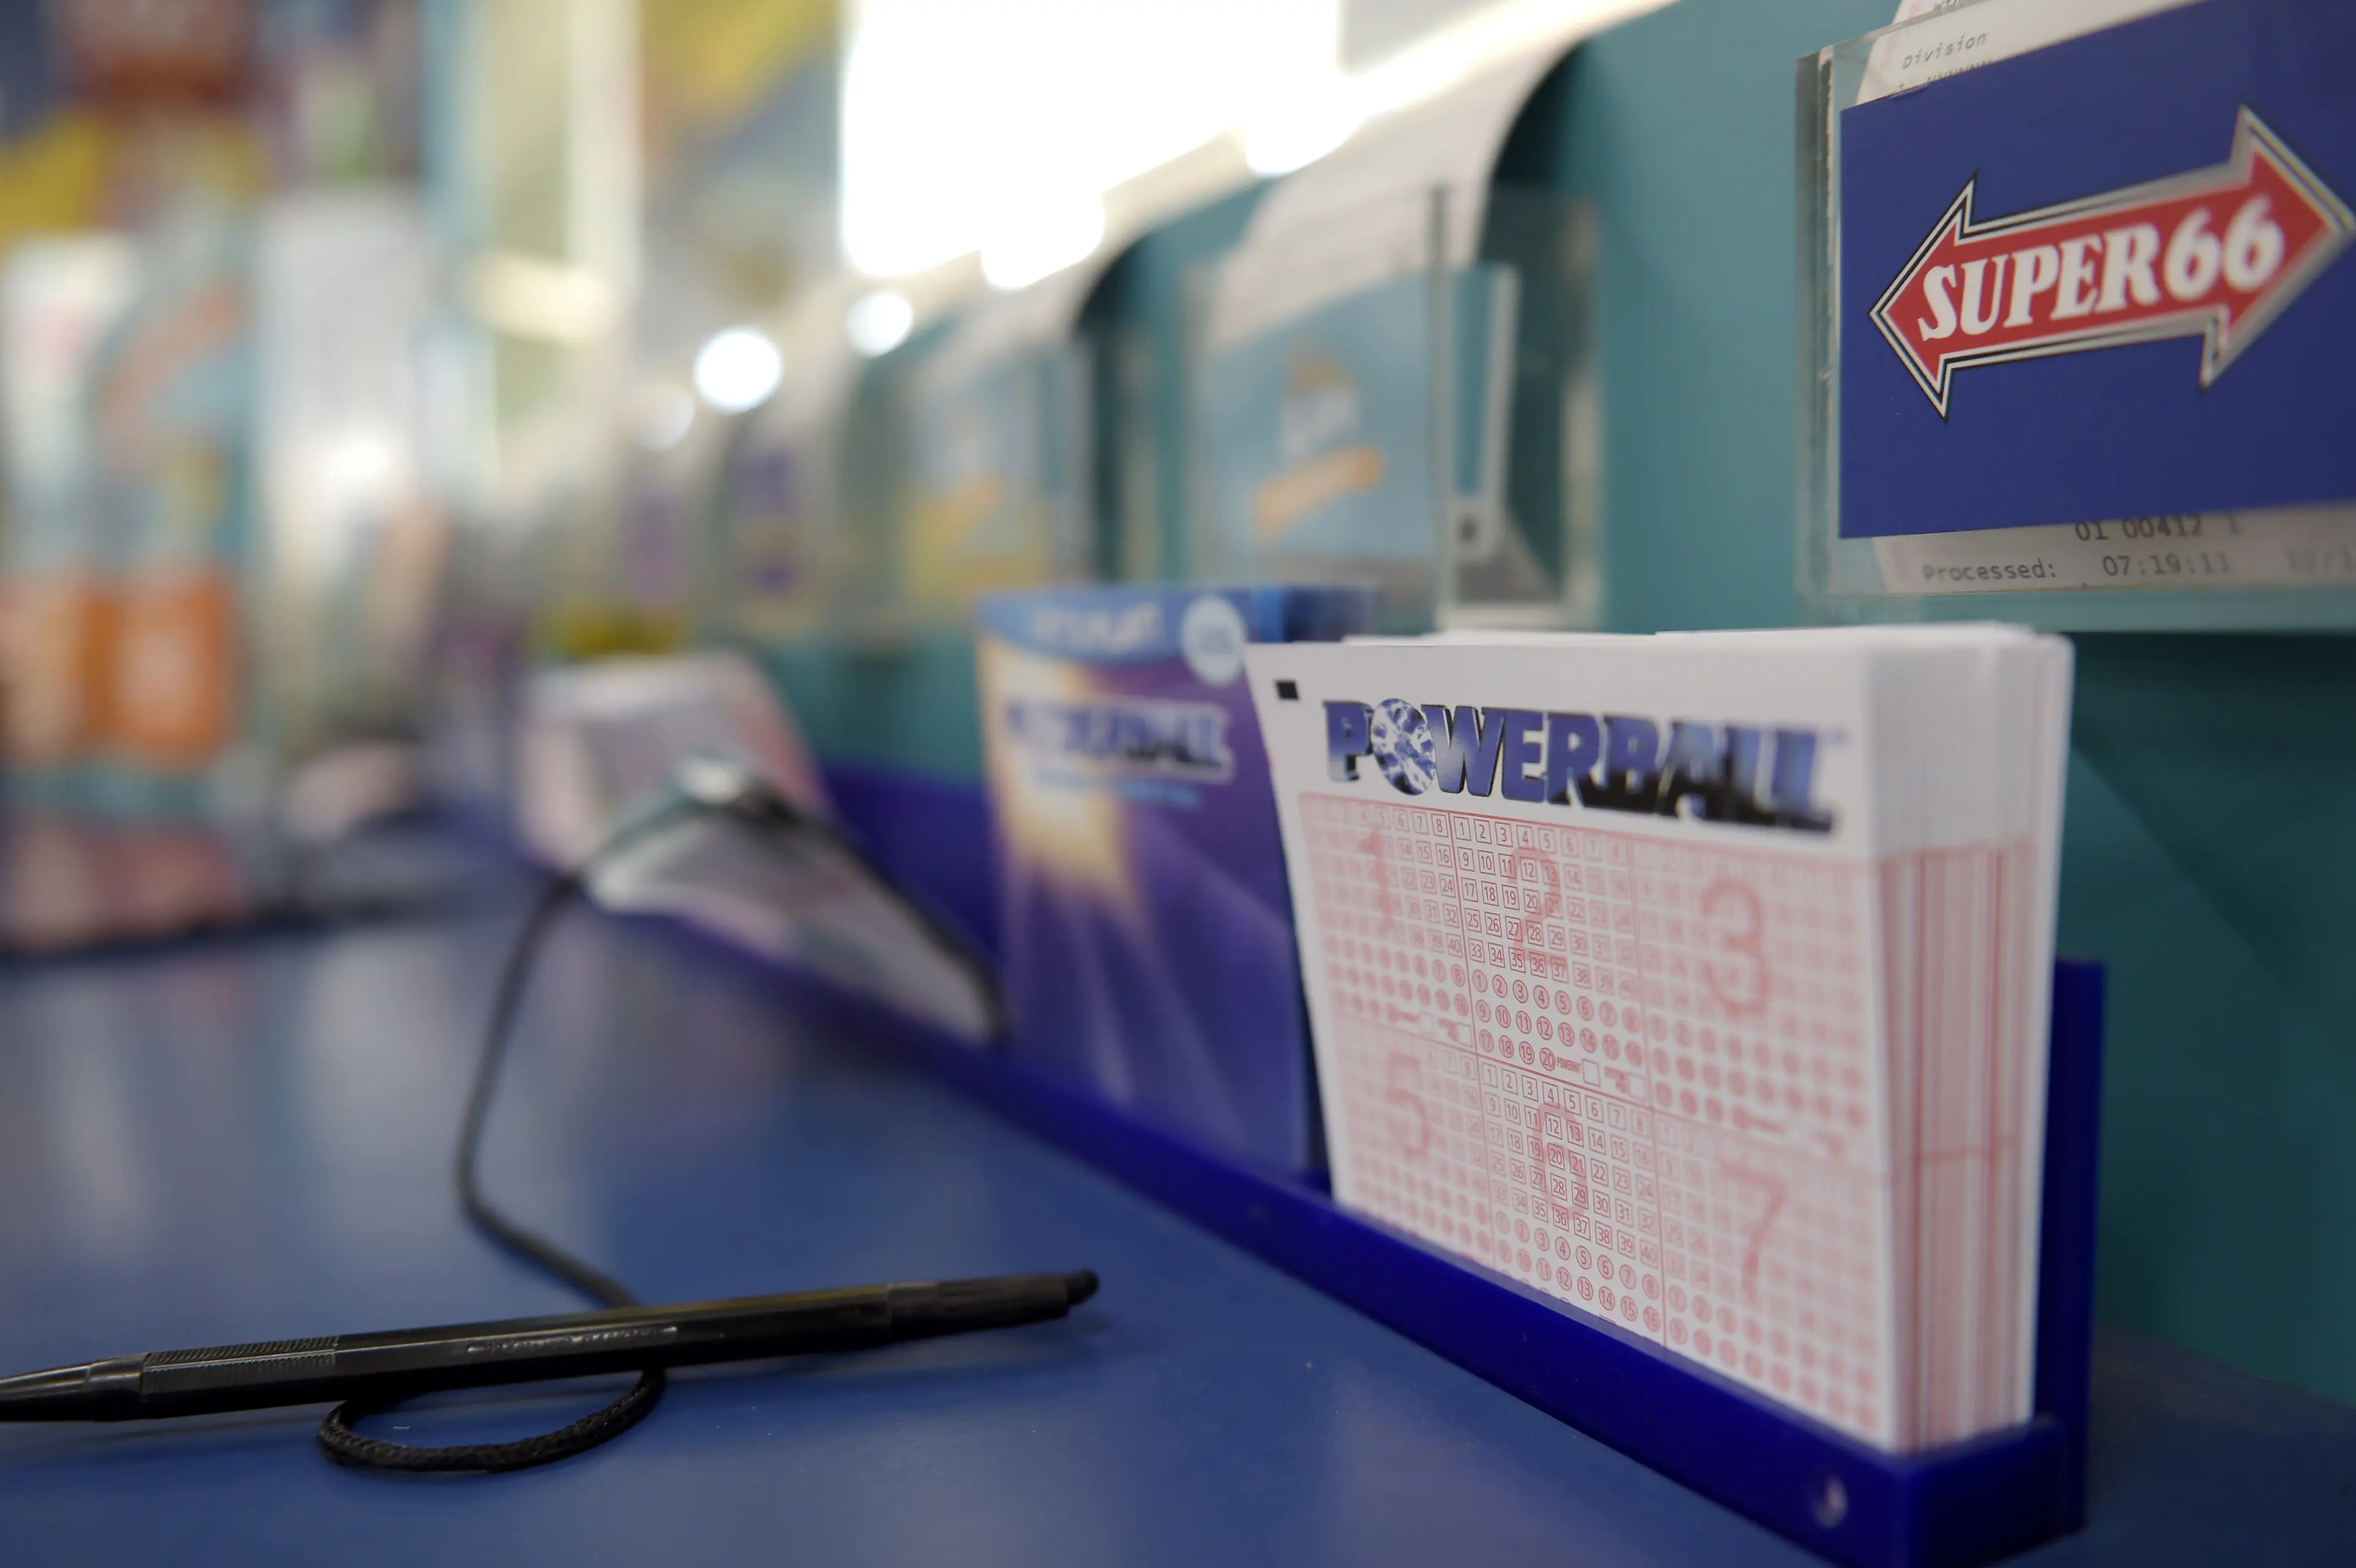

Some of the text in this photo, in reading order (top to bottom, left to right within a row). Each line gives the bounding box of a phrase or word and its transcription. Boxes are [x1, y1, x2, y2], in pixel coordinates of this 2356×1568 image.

[1903, 33, 1987, 70] Division
[1922, 551, 2233, 582] Processed: 07:19:11
[1322, 698, 1836, 834] POWERBALL
[1397, 812, 1405, 827] 6
[1416, 816, 1423, 829] 7
[1436, 818, 1443, 832] 8
[1460, 821, 1466, 836] 1
[1480, 824, 1487, 839] 2
[1500, 827, 1507, 842] 3
[1522, 830, 1529, 845] 4
[1543, 833, 1550, 848] 5
[1417, 845, 1430, 860] 15
[1438, 849, 1450, 864] 16
[1463, 852, 1470, 866] 9
[1480, 855, 1493, 870] 10
[1501, 858, 1513, 874] 11
[1522, 862, 1534, 878] 12
[1422, 874, 1434, 888] 23
[1442, 878, 1454, 893] 24
[1464, 882, 1476, 897] 17
[1484, 886, 1496, 901] 18
[1504, 890, 1517, 905] 19
[1525, 894, 1538, 910] 20
[1547, 898, 1560, 914] 21
[1426, 903, 1438, 918] 31
[1445, 908, 1457, 923] 32
[1468, 913, 1479, 928] 25
[1487, 917, 1499, 932] 26
[1507, 921, 1520, 937] 27
[1529, 926, 1541, 942] 28
[1550, 930, 1563, 947] 29
[1448, 939, 1461, 953] 40
[1471, 943, 1483, 958] 33
[1491, 948, 1503, 963] 34
[1511, 952, 1523, 968] 35
[1532, 957, 1544, 973] 36
[1553, 962, 1566, 978] 37
[1701, 876, 1773, 1018] 3
[1477, 974, 1483, 988] 1
[1496, 979, 1503, 994] 2
[1517, 984, 1524, 999] 3
[1538, 990, 1545, 1005] 4
[1559, 995, 1567, 1010] 5
[1480, 1004, 1487, 1018] 9
[1497, 1009, 1509, 1024] 10
[1518, 1014, 1529, 1030] 11
[1538, 1020, 1551, 1036] 12
[1560, 1026, 1573, 1042] 13
[1480, 1033, 1553, 1067] 17 18 19 20
[1385, 1051, 1433, 1161] 5
[1487, 1068, 1493, 1082] 1
[1506, 1074, 1514, 1089] 2
[1526, 1081, 1534, 1096] 3
[1547, 1087, 1555, 1102] 4
[1569, 1094, 1576, 1110] 5
[1591, 1101, 1598, 1116] 6
[1614, 1109, 1621, 1124] 7
[1489, 1097, 1496, 1112] 9
[1506, 1104, 1519, 1119] 10
[1527, 1111, 1538, 1126] 11
[1547, 1118, 1560, 1134] 12
[1569, 1125, 1581, 1141] 13
[1591, 1132, 1603, 1149] 14
[1613, 1140, 1626, 1157] 15
[1489, 1127, 1501, 1142] 17
[1509, 1134, 1520, 1149] 18
[1529, 1141, 1541, 1156] 19
[1550, 1148, 1562, 1164] 20
[1571, 1156, 1584, 1172] 21
[1593, 1164, 1606, 1180] 22
[1511, 1164, 1523, 1179] 26
[1531, 1171, 1544, 1187] 27
[1552, 1179, 1565, 1195] 28
[1573, 1188, 1586, 1204] 29
[1595, 1196, 1608, 1212] 30
[1618, 1204, 1631, 1221] 31
[1514, 1193, 1525, 1209] 34
[1534, 1202, 1546, 1217] 35
[1554, 1210, 1567, 1226] 36
[1576, 1218, 1588, 1234] 37
[1598, 1227, 1611, 1243] 38
[1620, 1236, 1633, 1253] 39
[1719, 1158, 1788, 1304] 7
[1519, 1224, 1525, 1239] 2
[1538, 1232, 1546, 1247] 3
[1559, 1240, 1566, 1256] 4
[1580, 1250, 1588, 1265] 5
[1601, 1259, 1609, 1275] 6
[1624, 1269, 1632, 1285] 7
[1538, 1261, 1549, 1277] 11
[1558, 1270, 1571, 1286] 12
[1579, 1280, 1592, 1296] 13
[1601, 1290, 1613, 1307] 14
[1623, 1301, 1636, 1317] 15
[1646, 1310, 1658, 1328] 16
